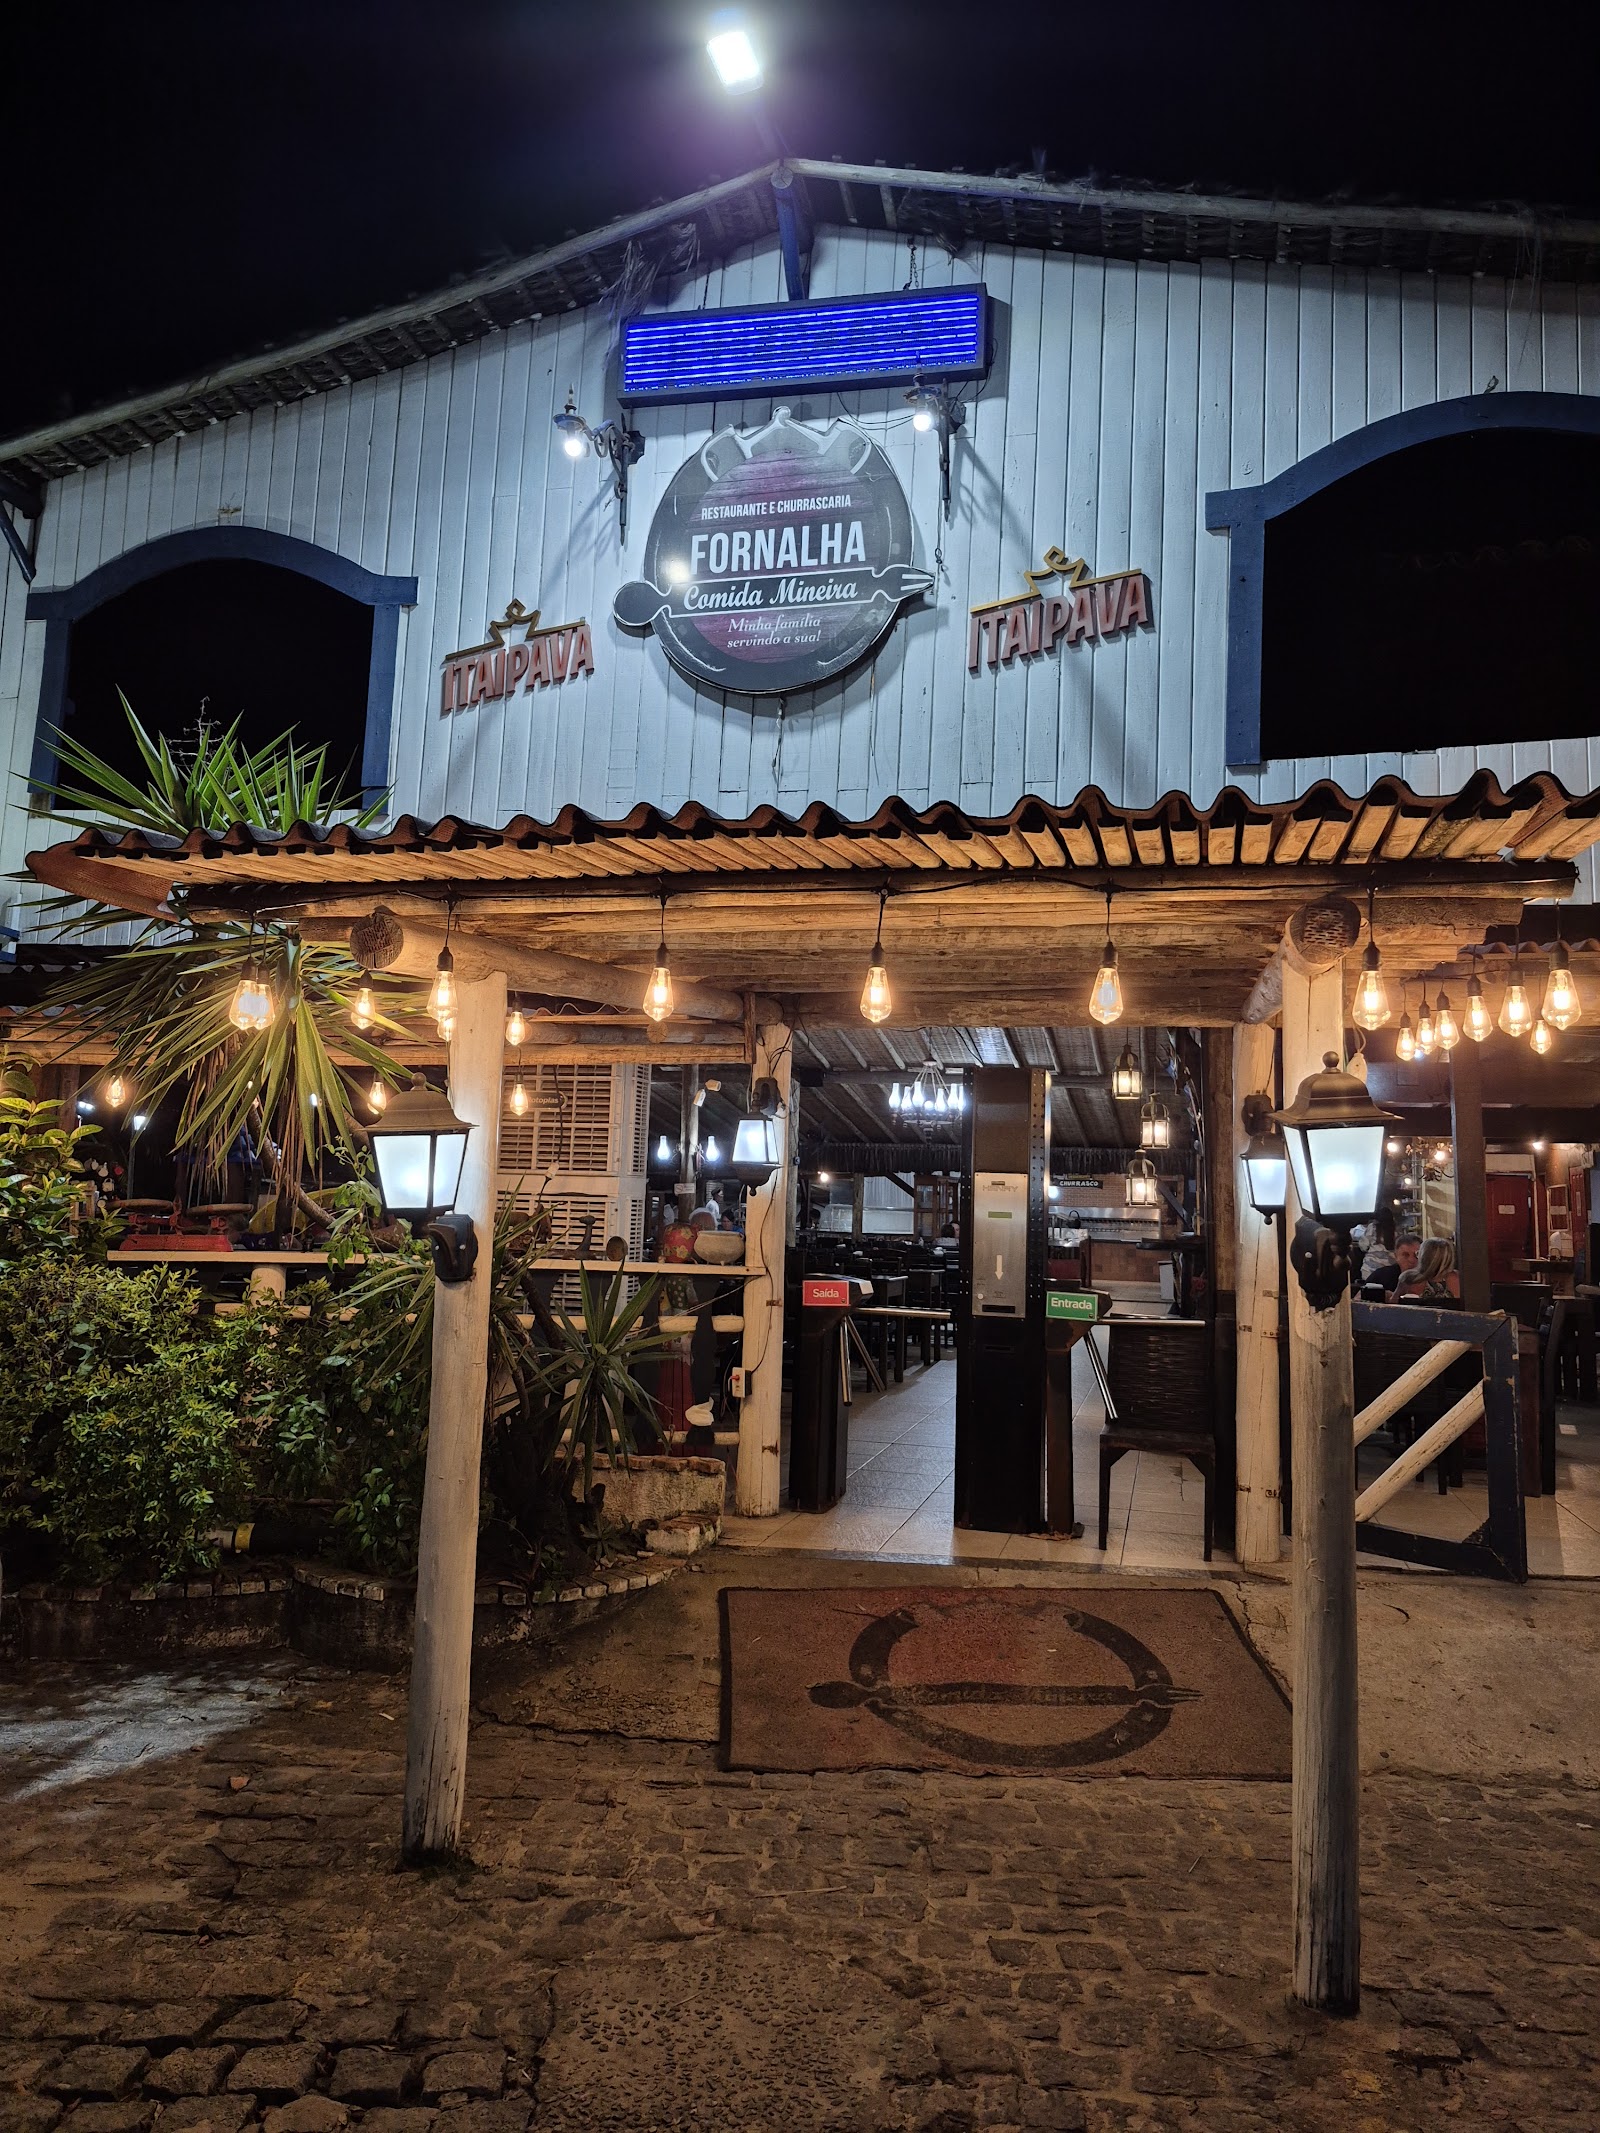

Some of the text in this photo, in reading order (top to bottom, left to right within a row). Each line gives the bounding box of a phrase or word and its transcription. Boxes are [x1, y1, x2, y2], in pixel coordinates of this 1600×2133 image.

[701, 494, 851, 520] RESTAURANTE E CHURRASCARIA
[690, 520, 866, 575] FORNALHA
[683, 577, 858, 611] Comida Mineira
[727, 612, 821, 633] Minha família
[968, 574, 1148, 670] ITAIPAVA
[727, 630, 821, 648] servindo a sua!
[443, 623, 594, 712] ITAIPAVA
[812, 1288, 839, 1298] Saída
[1051, 1297, 1092, 1310] Entrada
